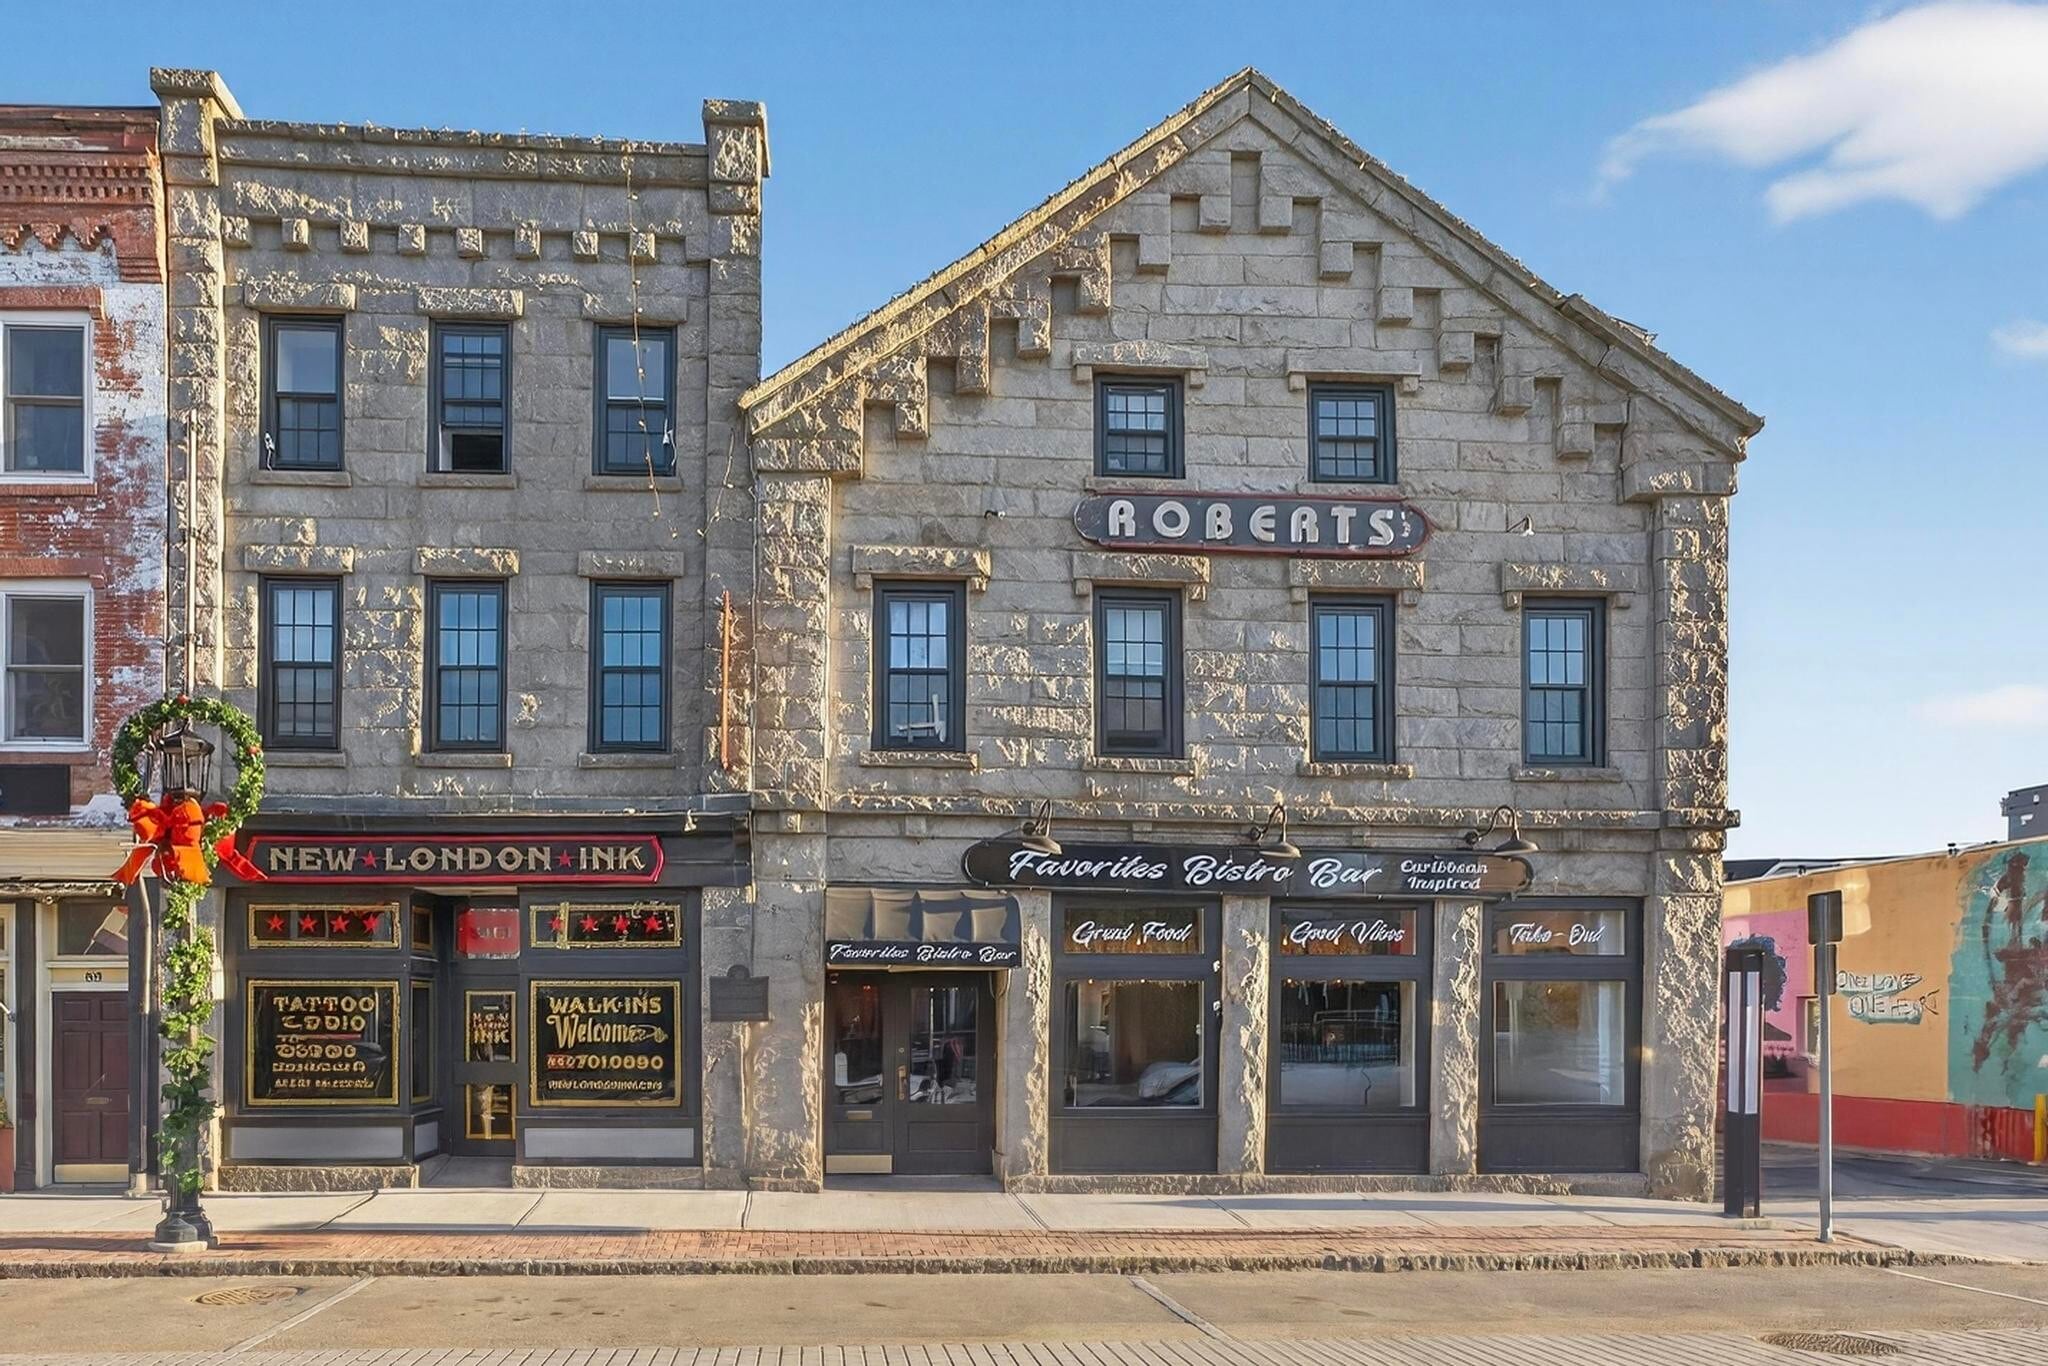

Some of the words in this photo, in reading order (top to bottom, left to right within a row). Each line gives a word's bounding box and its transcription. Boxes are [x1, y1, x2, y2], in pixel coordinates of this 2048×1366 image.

[269, 846, 357, 872] NEW
[384, 846, 552, 873] LONDON
[579, 846, 647, 871] INK
[1009, 849, 1168, 880] Favorites
[1183, 855, 1294, 886] Bistro
[1308, 857, 1383, 888] Bar
[1142, 920, 1193, 943] Food
[1289, 921, 1345, 949] Good
[272, 996, 375, 1013] TATTOO
[546, 1013, 647, 1049] Welcome
